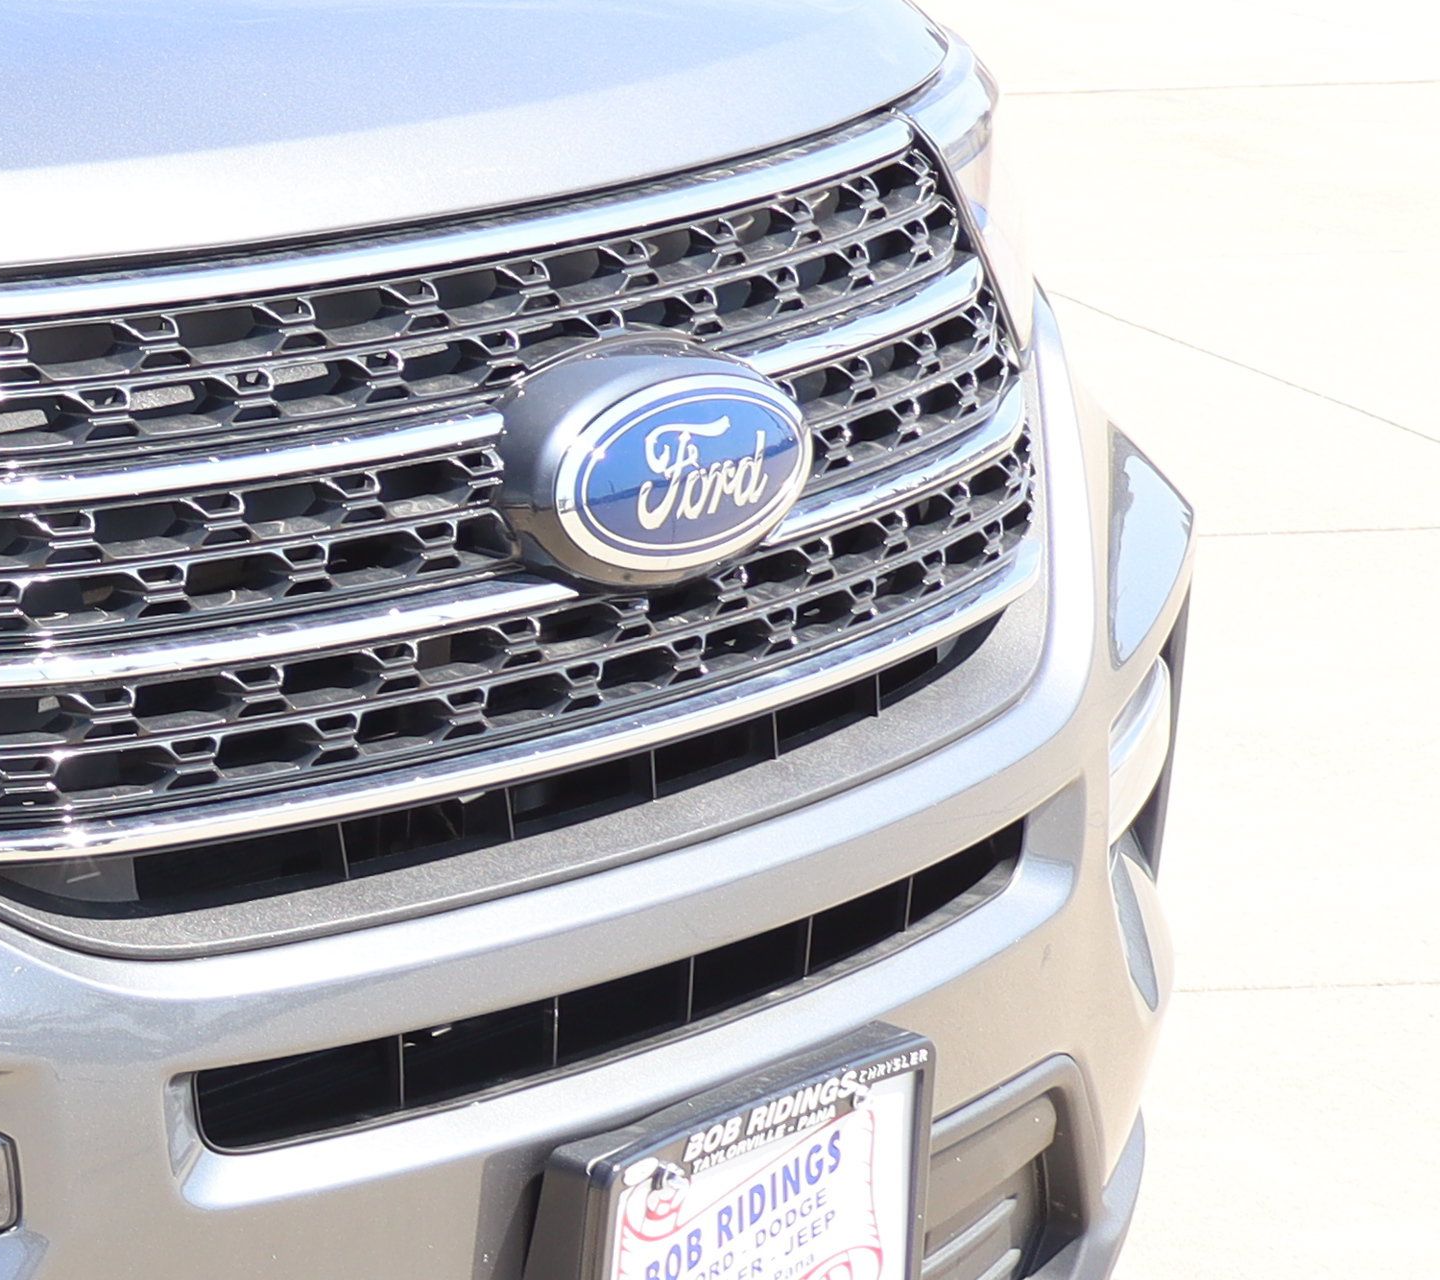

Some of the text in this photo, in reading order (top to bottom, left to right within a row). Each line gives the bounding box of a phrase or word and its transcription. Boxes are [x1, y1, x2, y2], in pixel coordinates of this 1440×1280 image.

[637, 415, 769, 530] Ford
[859, 1048, 929, 1084] CHRYSLER
[683, 1070, 860, 1163] BOB RIDINGS
[691, 1127, 785, 1175] TAYLORVILLE
[796, 1105, 836, 1133] PANA
[717, 1130, 842, 1249] RIDINGS
[755, 1188, 827, 1249] DODGE
[784, 1210, 836, 1257] JEEP
